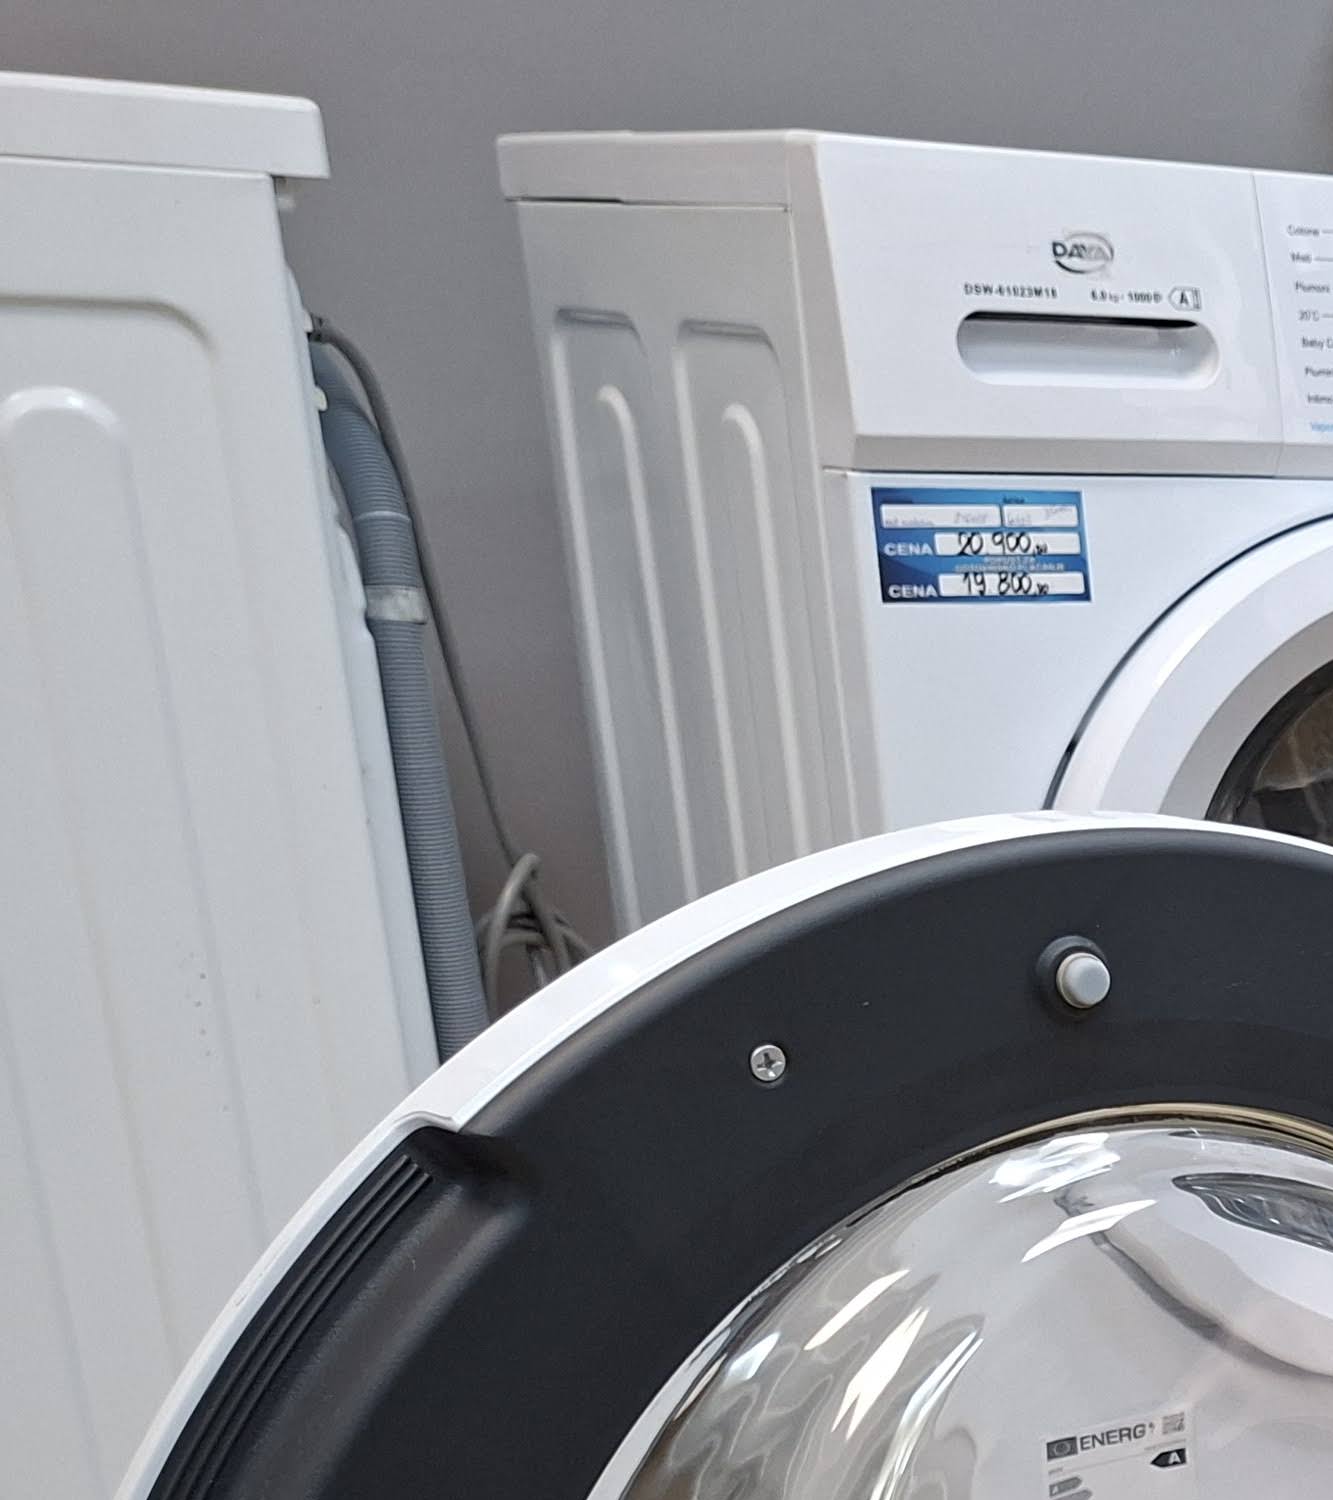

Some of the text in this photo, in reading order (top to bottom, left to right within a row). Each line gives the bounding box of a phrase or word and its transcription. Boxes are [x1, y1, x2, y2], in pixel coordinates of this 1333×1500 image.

[884, 543, 933, 557] CENA
[888, 585, 938, 598] CENA
[1079, 1423, 1146, 1451] ENERG
[1168, 1451, 1182, 1465] A
